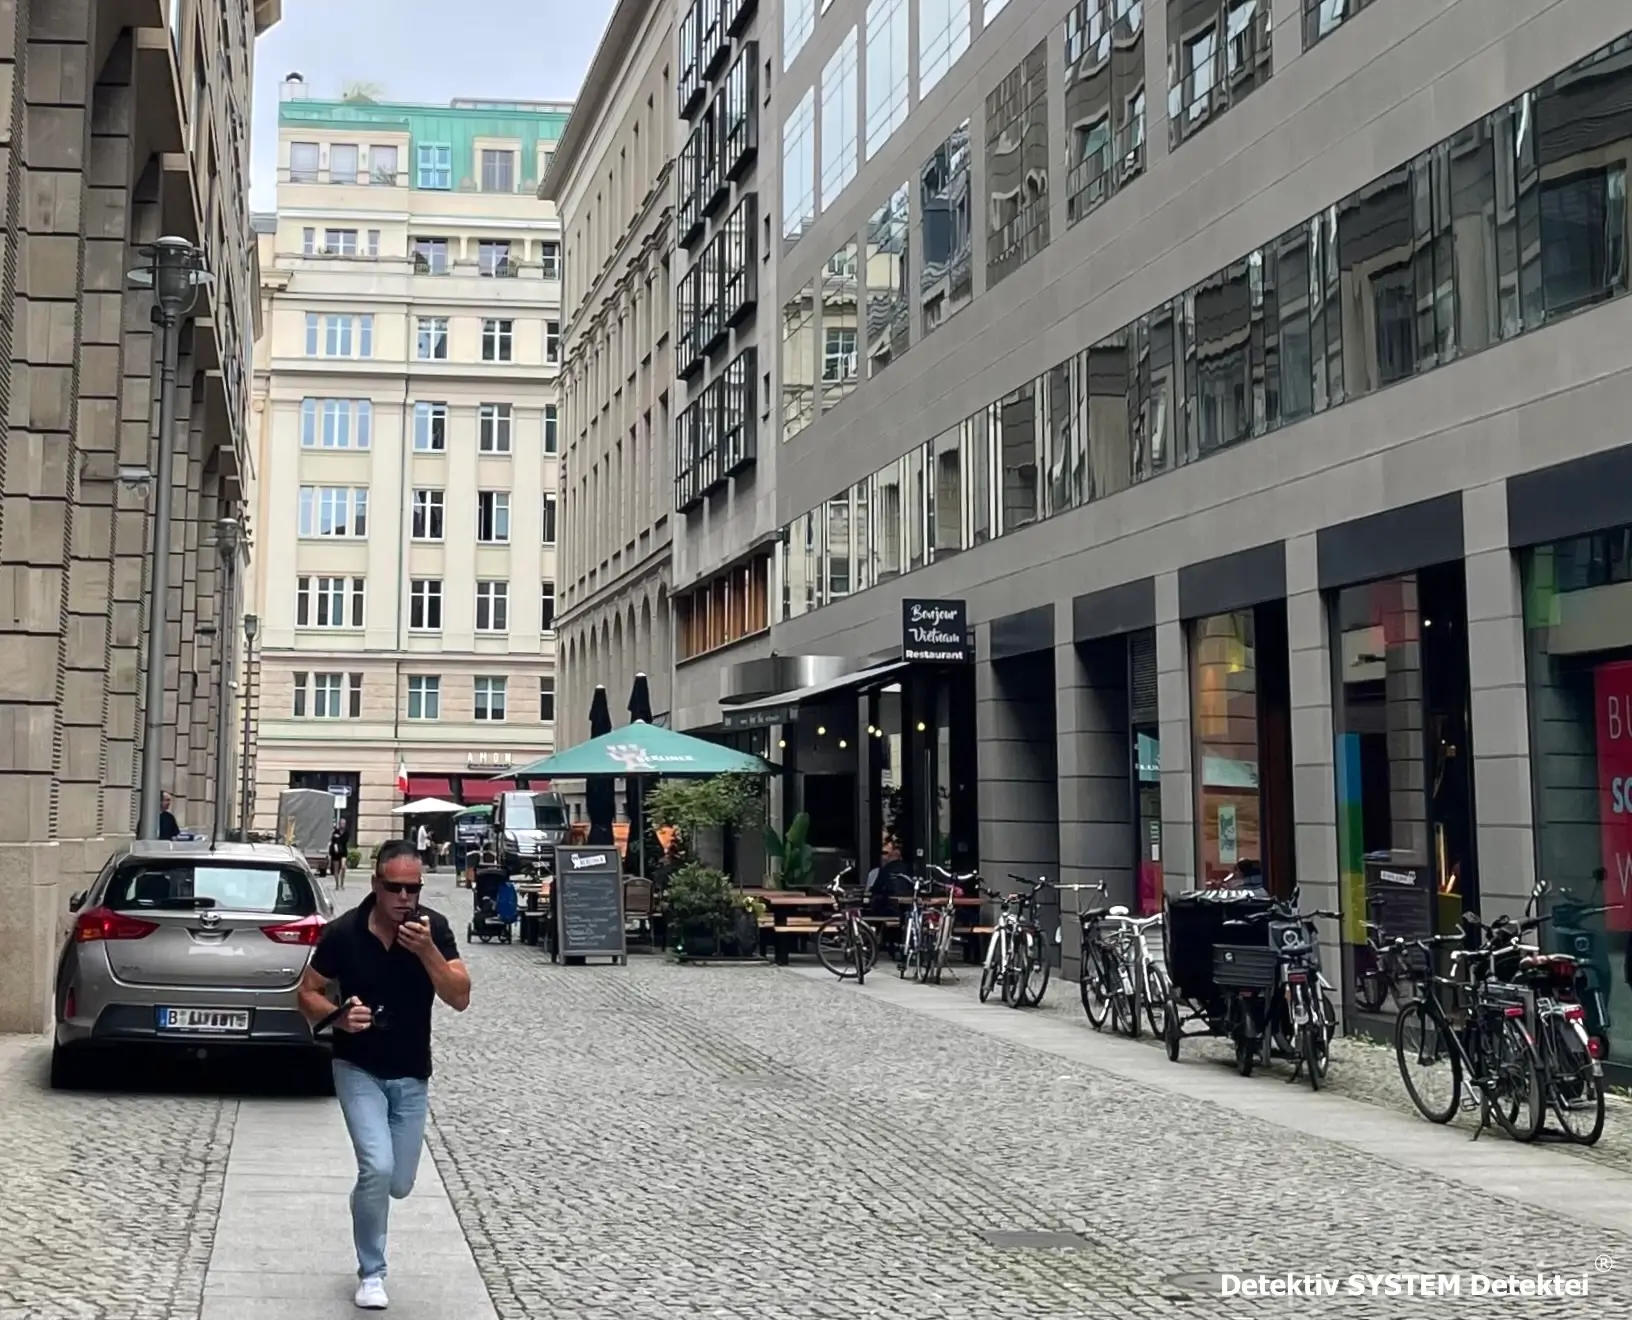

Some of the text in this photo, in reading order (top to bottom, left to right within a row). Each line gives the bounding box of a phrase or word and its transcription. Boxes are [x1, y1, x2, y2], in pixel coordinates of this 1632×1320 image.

[911, 604, 958, 625] Bonjour
[908, 626, 960, 643] Vietnam
[905, 649, 964, 660] Restaurant
[467, 752, 512, 764] AMON
